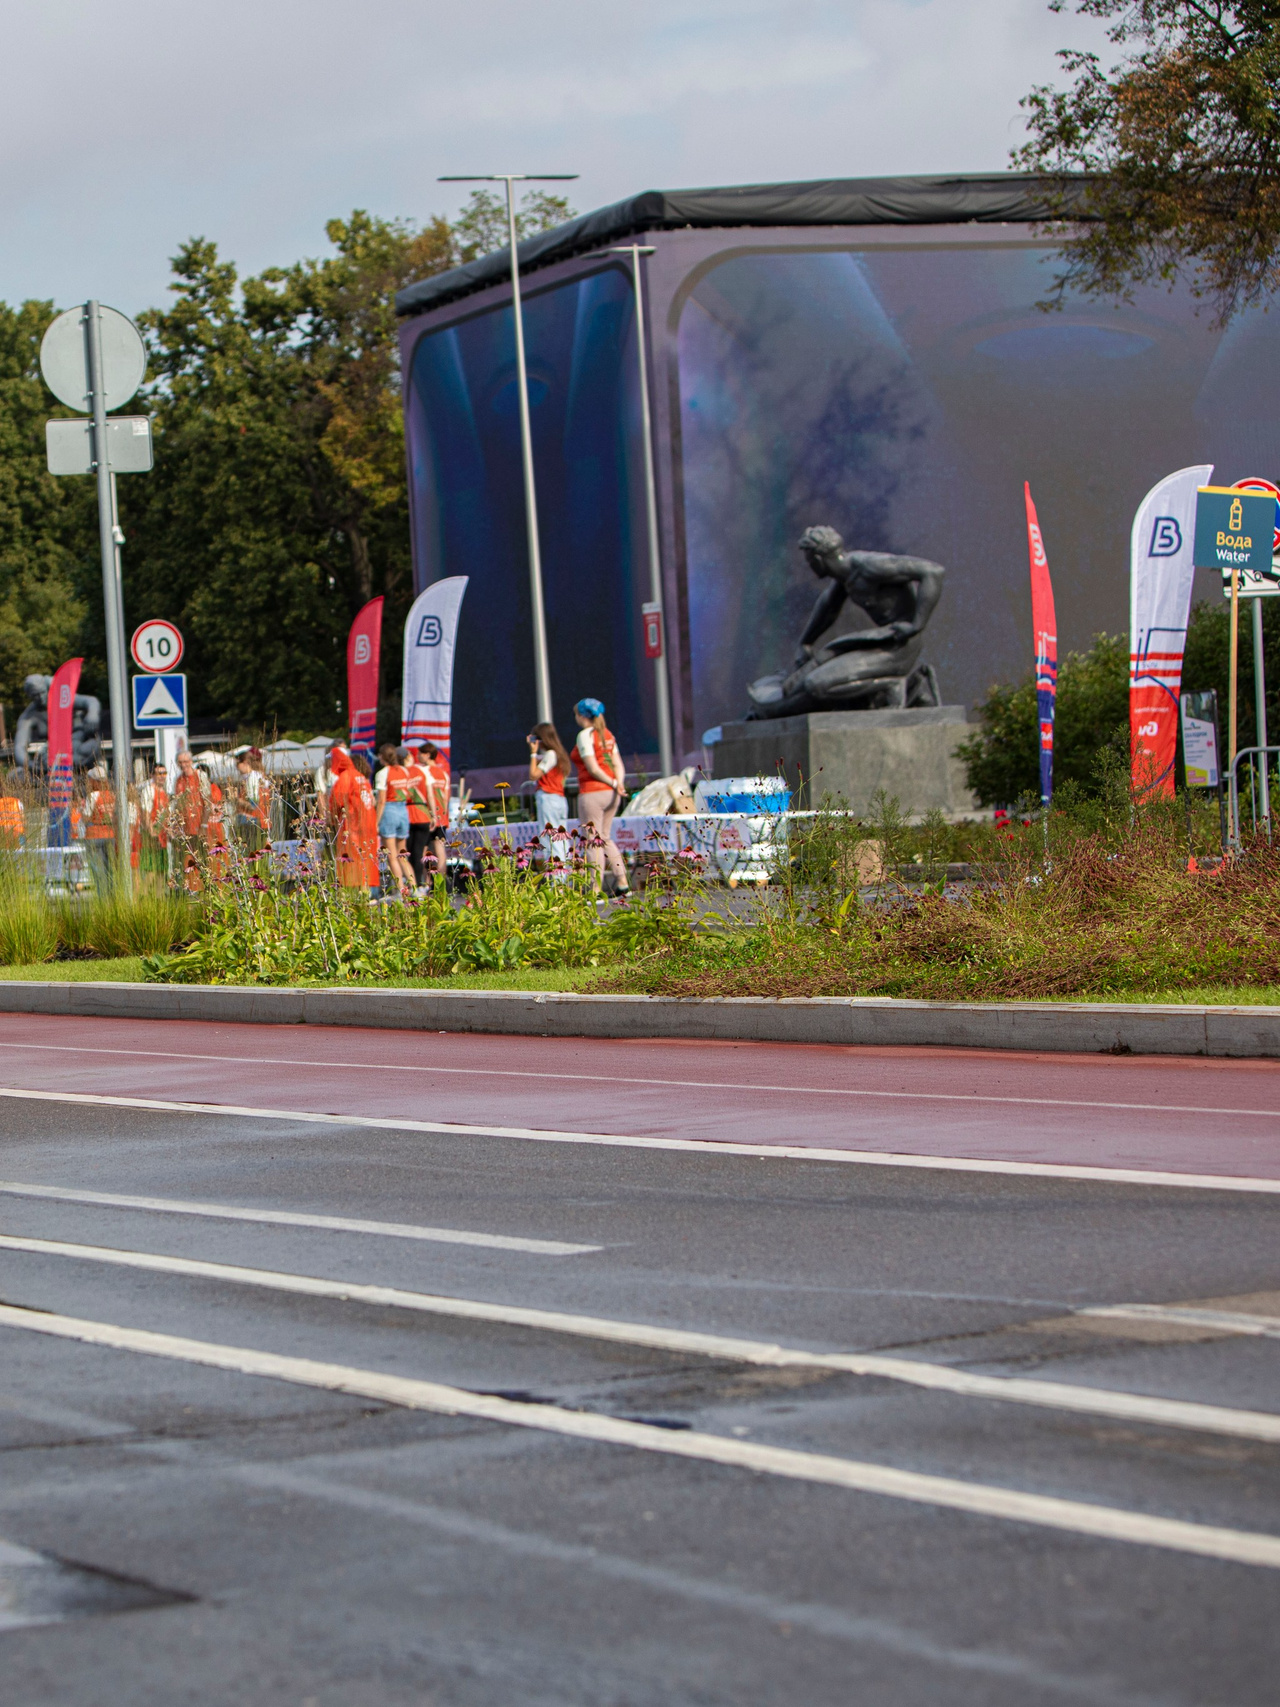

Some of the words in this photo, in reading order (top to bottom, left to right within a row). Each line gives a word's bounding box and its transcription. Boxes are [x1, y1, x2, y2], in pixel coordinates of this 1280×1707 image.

[1216, 531, 1252, 550] Вода
[1216, 549, 1250, 562] Water
[146, 637, 171, 658] 10
